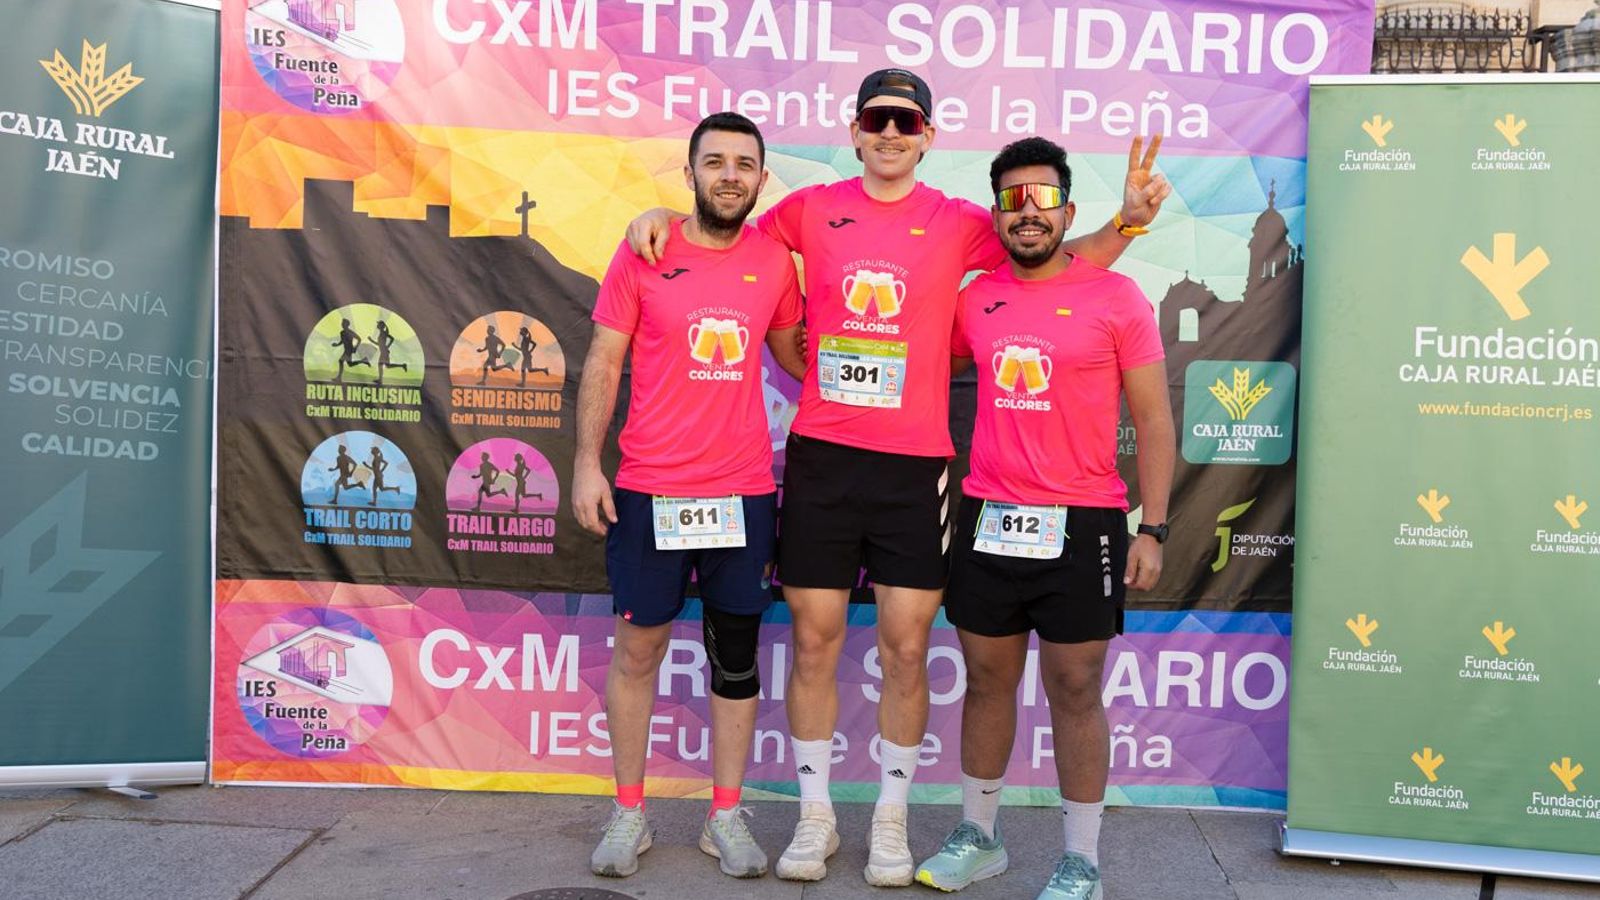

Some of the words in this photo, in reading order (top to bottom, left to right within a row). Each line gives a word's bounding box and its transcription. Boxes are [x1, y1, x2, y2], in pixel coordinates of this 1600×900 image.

[253, 28, 286, 48] IES
[433, 0, 598, 50] CxM
[626, 0, 858, 63] TRAIL
[884, 3, 1329, 76] SOLIDARIO
[274, 53, 338, 73] Fuente
[314, 75, 326, 85] de
[330, 75, 339, 85] la
[313, 87, 358, 107] Peña
[548, 69, 639, 119] IES
[990, 86, 1037, 135] la
[1060, 90, 1209, 139] Peña
[0, 111, 68, 143] CAJA
[75, 122, 175, 160] RURAL
[1344, 148, 1411, 162] Fundación
[1477, 147, 1546, 161] Fundación
[45, 148, 121, 180] JAÉN
[1339, 163, 1360, 171] CAJA
[1363, 163, 1391, 171] RURAL
[1394, 161, 1416, 171] JAÉN
[1471, 162, 1494, 171] CAJA
[1496, 162, 1525, 171] RURAL
[1528, 160, 1551, 171] JAÉN
[842, 259, 909, 279] RESTAURANTE
[17, 281, 168, 317] CERCANÍA
[687, 306, 750, 325] RESTAURANTE
[855, 315, 888, 324] VENTA
[842, 320, 900, 335] COLORES
[992, 334, 1056, 354] RESTAURANTE
[1415, 326, 1599, 362] Fundación
[0, 339, 214, 380] RANSPARENCI
[702, 363, 734, 371] VENTA
[688, 369, 744, 381] COLORES
[840, 364, 879, 384] 301
[1399, 363, 1459, 384] CAJA
[1465, 364, 1546, 386] RURAL
[1552, 362, 1600, 388] JAÉ
[8, 372, 181, 408] SOLVENCIA
[306, 384, 344, 401] RUTA
[346, 385, 422, 406] INCLUSIVA
[1006, 392, 1038, 400] VENTA
[451, 388, 562, 411] SENDERISMO
[994, 397, 1052, 412] COLORES
[54, 403, 178, 433] SOLIDEZ
[306, 405, 330, 418] CxM
[333, 406, 362, 420] TRAIL
[364, 408, 421, 422] SOLIDARIO
[1418, 402, 1592, 423] www.fundacioncrj.es
[451, 413, 473, 426] CxM
[476, 414, 504, 427] TRAIL
[506, 416, 561, 430] SOLIDARIO
[1192, 424, 1228, 438] CAJA
[1232, 425, 1283, 438] RURAL
[21, 432, 159, 461] CALIDAD
[1217, 436, 1256, 452] JAÉN
[304, 508, 351, 528] TRAIL
[354, 510, 413, 531] CORTO
[446, 514, 494, 535] TRAIL
[498, 517, 556, 537] LARGO
[679, 508, 718, 526] 611
[1002, 514, 1040, 534] 612
[304, 531, 325, 544] CxM
[328, 533, 356, 546] TRAIL
[358, 534, 412, 548] SOLIDARIO
[1399, 523, 1468, 539] Fundación
[447, 538, 469, 551] CxM
[471, 539, 499, 553] TRAIL
[500, 541, 553, 554] SOLIDARIO
[1231, 546, 1247, 556] DE
[1248, 546, 1277, 557] JAÉN
[1394, 537, 1417, 546] CAJA
[1418, 538, 1448, 548] RURAL
[1450, 538, 1473, 549] JAÉN
[1530, 543, 1554, 552] CAJA
[1556, 544, 1586, 554] RURAL
[1328, 647, 1397, 664] Fundación
[1464, 655, 1535, 672] Fundación
[418, 628, 580, 693] CxM
[861, 645, 1288, 711] SOIARIO
[1323, 661, 1346, 671] CAJA
[1347, 662, 1377, 672] RURAL
[1379, 662, 1402, 673] JAÉN
[1459, 669, 1483, 679] CAJA
[1484, 670, 1514, 681] RURAL
[1516, 671, 1540, 682] JAÉN
[244, 680, 277, 698] IES
[265, 702, 328, 719] Fuente
[303, 720, 315, 730] de
[318, 720, 328, 730] la
[302, 732, 346, 750] Peña
[529, 710, 613, 758] IES
[1032, 724, 1174, 770] Pña
[1393, 782, 1463, 799] Fundación
[1388, 796, 1411, 805] CAJA
[1413, 798, 1443, 808] RURAL
[1445, 798, 1469, 810] JAÉN
[1526, 806, 1550, 816] CAJA
[1552, 808, 1583, 818] RURAL
